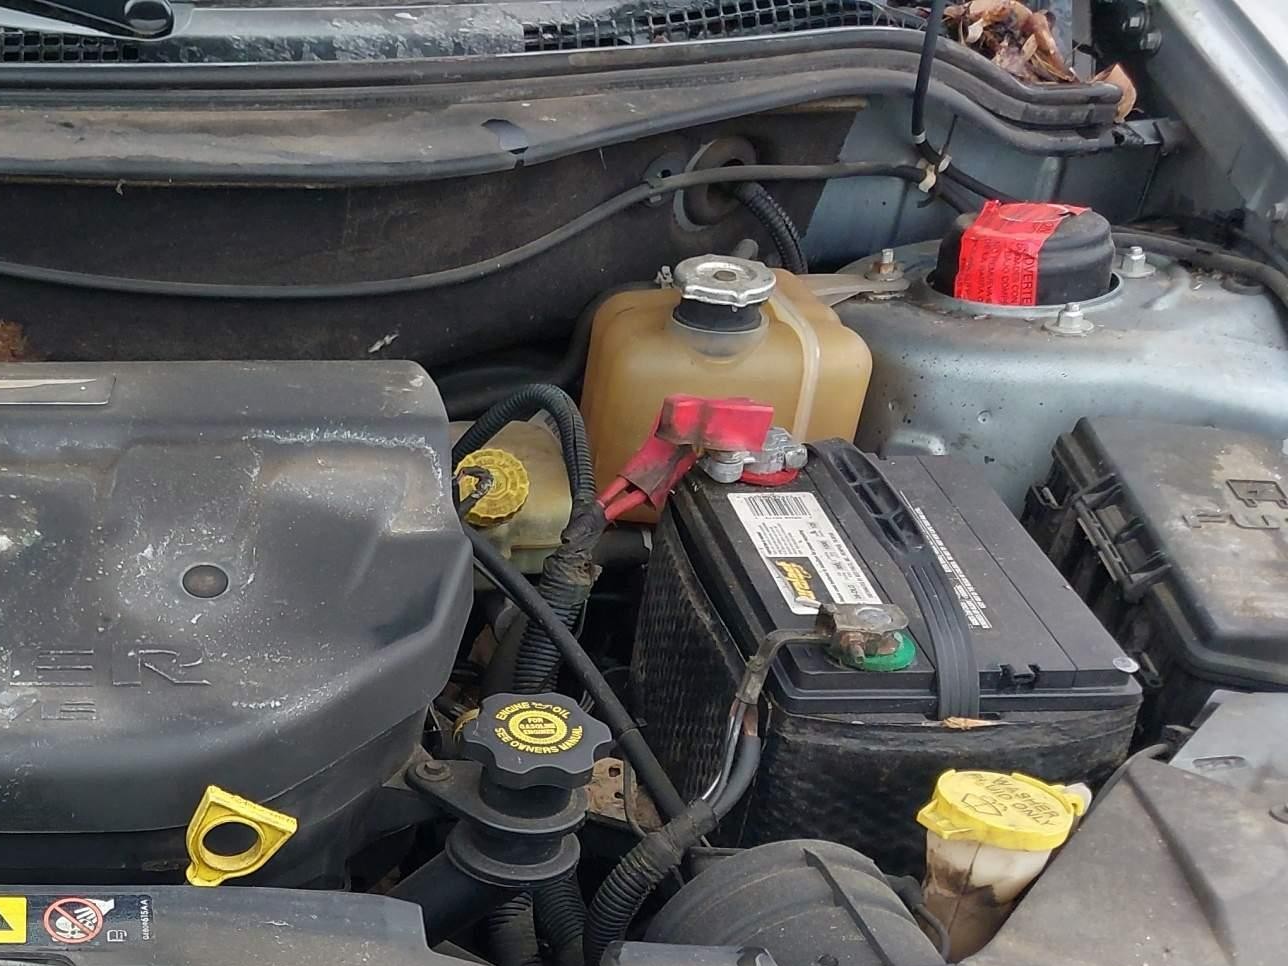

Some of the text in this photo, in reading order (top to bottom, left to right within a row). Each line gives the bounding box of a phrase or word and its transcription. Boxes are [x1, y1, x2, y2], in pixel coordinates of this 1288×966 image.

[496, 702, 571, 720] ENGINE OIL
[495, 725, 583, 754] SEE OWNERS MANUAL
[971, 774, 1056, 827] FLUID ONLY
[991, 776, 1060, 819] WASHER
